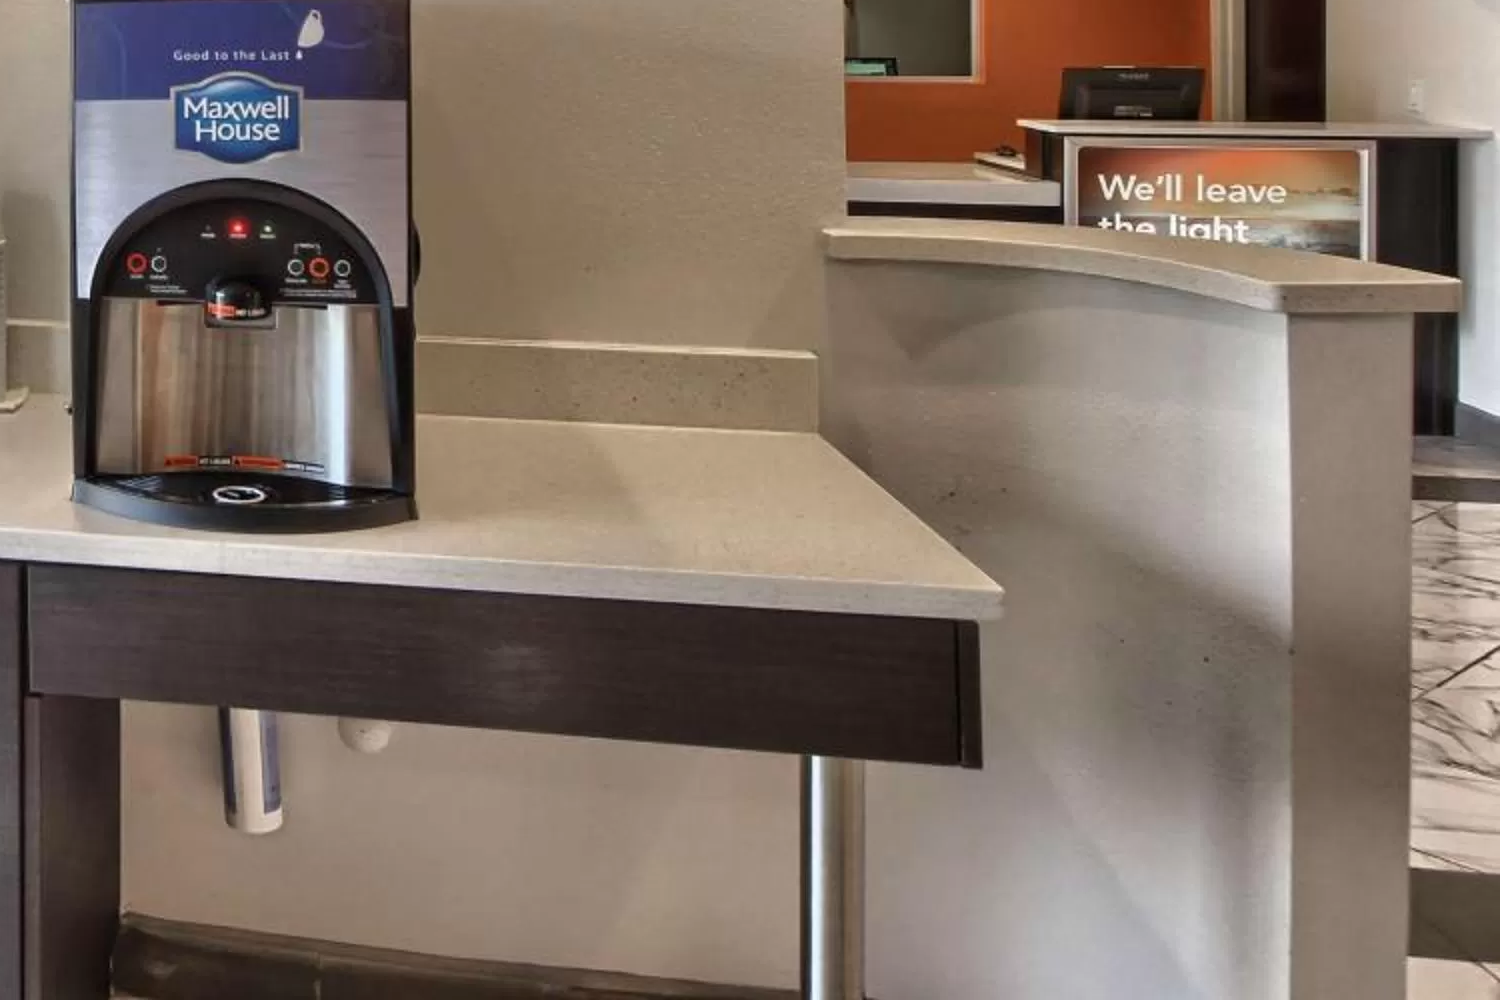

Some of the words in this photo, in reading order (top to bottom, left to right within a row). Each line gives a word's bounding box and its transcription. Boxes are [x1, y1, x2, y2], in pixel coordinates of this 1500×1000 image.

[173, 49, 209, 61] Good
[214, 50, 229, 61] to
[233, 49, 256, 61] the
[261, 49, 289, 61] Last
[183, 95, 289, 121] Maxwell
[195, 119, 280, 142] House
[1098, 173, 1182, 202] We'll
[1197, 175, 1287, 204] leave
